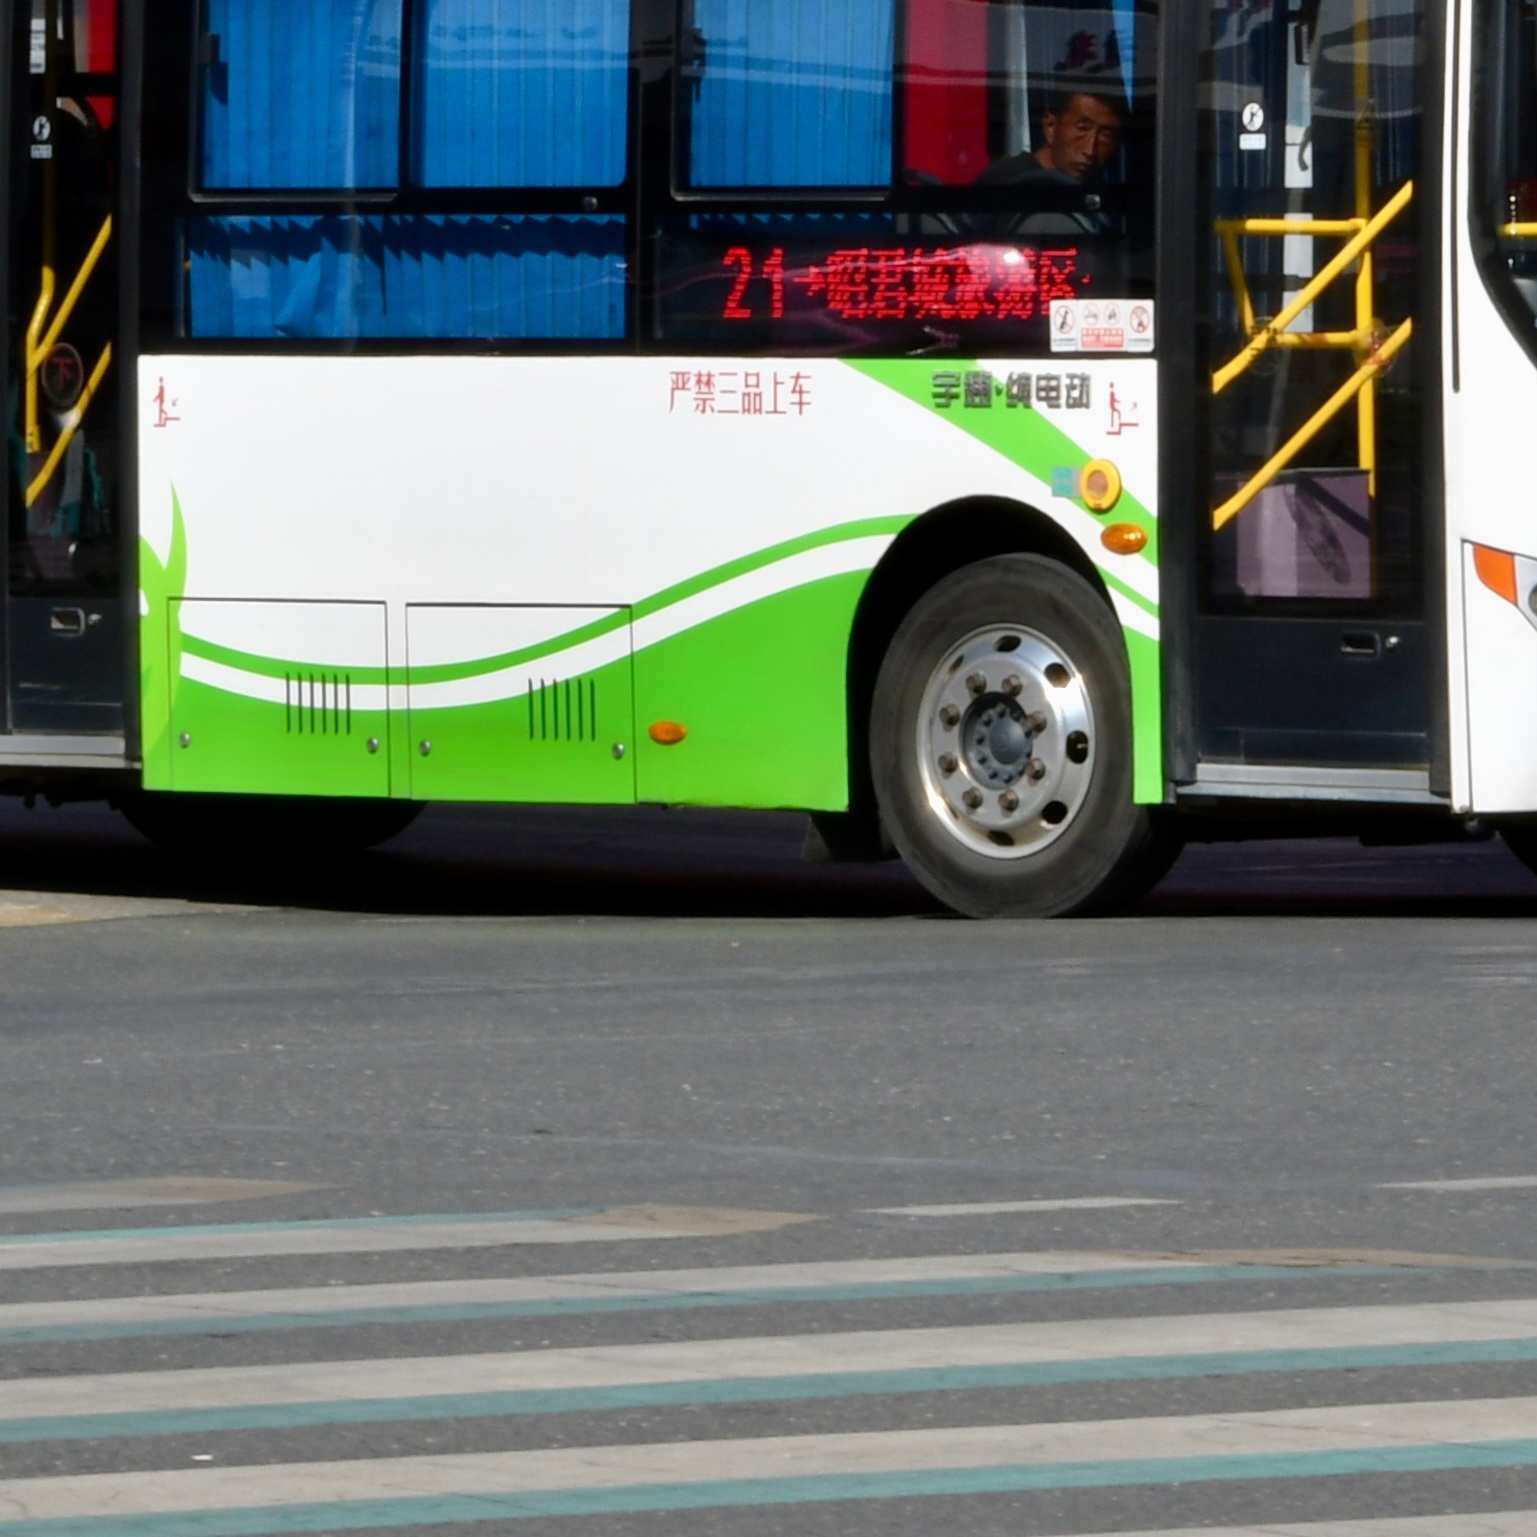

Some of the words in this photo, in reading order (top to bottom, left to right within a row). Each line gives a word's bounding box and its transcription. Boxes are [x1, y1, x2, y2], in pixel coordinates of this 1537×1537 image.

[721, 247, 786, 320] 21
[668, 369, 812, 417] 严禁三品上车
